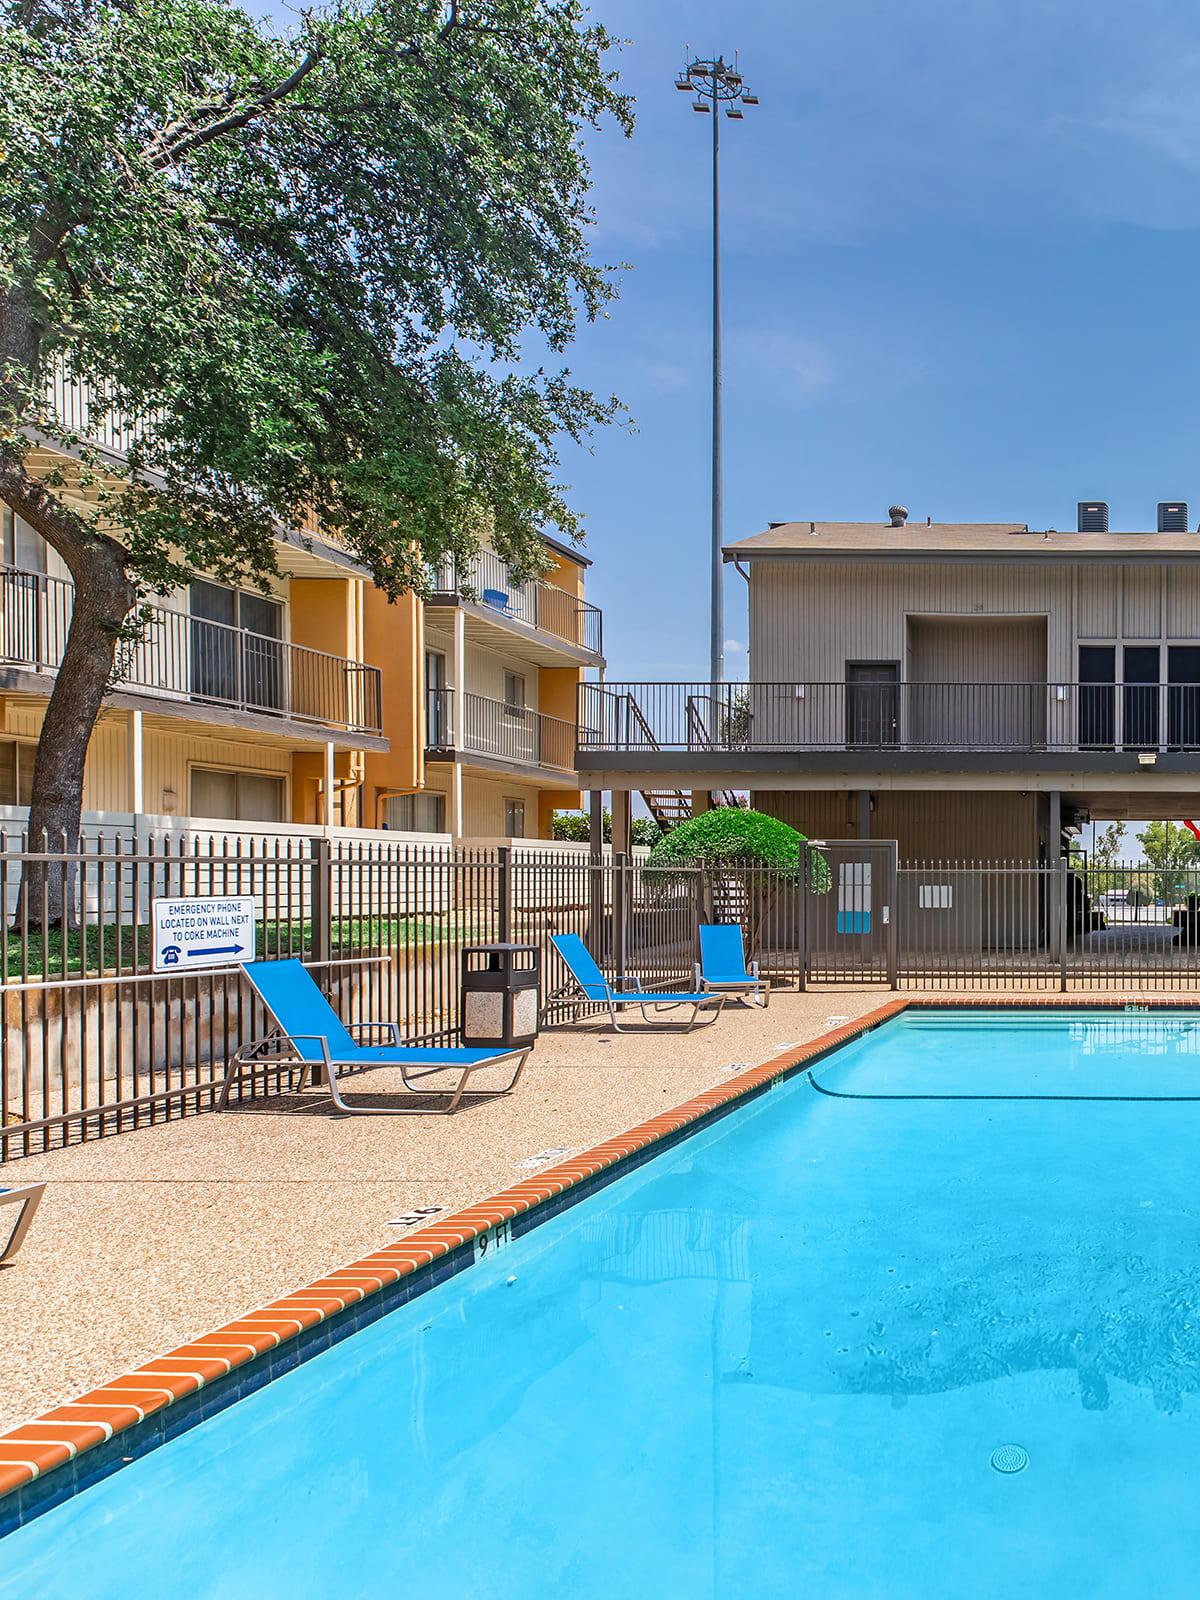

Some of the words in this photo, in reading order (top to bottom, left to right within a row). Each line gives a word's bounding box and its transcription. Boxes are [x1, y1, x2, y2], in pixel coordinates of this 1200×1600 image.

[168, 904, 216, 915] EMERGENCY
[217, 902, 242, 912] PHONE
[160, 918, 196, 929] LOCATED
[197, 917, 208, 926] ON
[209, 916, 229, 926] WALL
[231, 914, 249, 924] NEXT
[172, 932, 182, 941] TO
[184, 930, 204, 940] COKE
[206, 928, 240, 939] MACHINE
[480, 1235, 488, 1257] 9
[496, 1223, 509, 1248] FT
